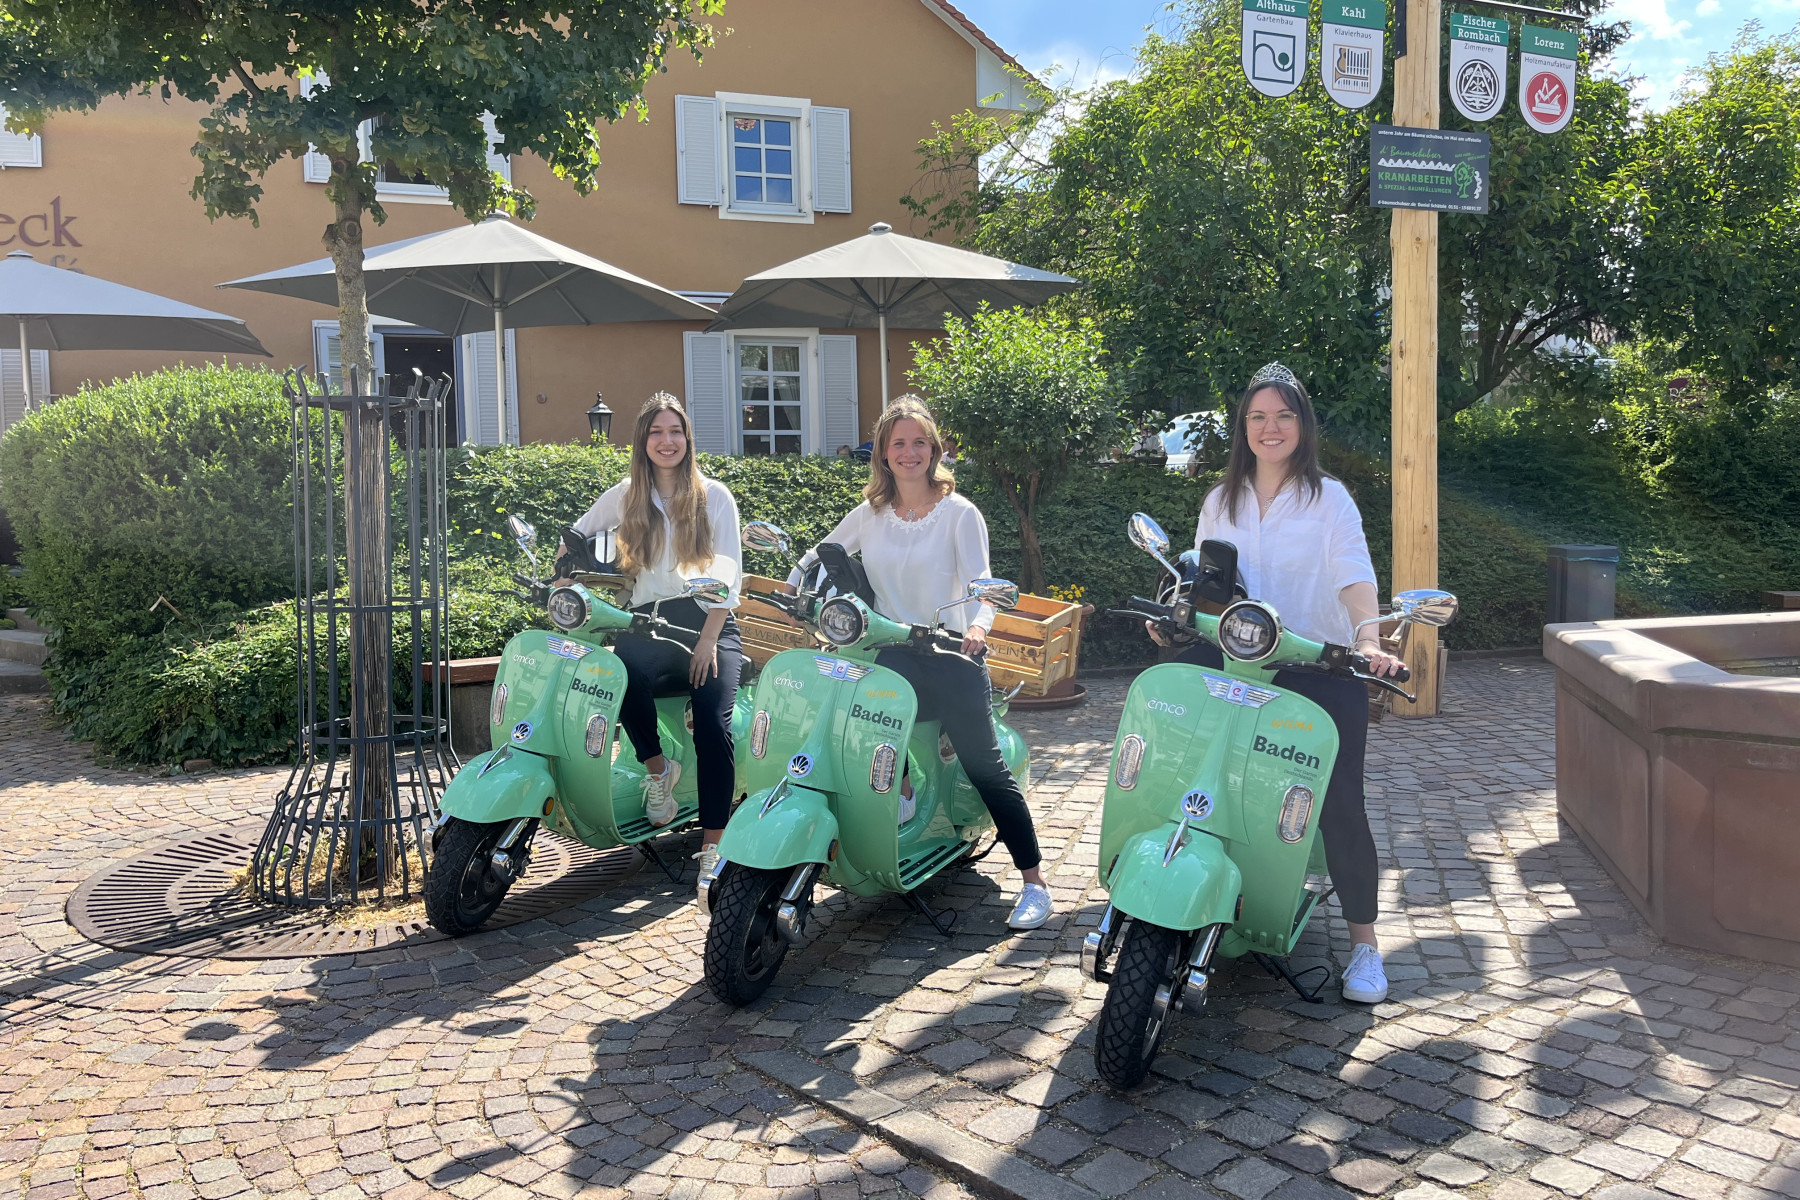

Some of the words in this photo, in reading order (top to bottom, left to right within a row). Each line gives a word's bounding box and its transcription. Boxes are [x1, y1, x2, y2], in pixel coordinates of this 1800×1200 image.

[1256, 0, 1296, 13] Althaus
[1341, 6, 1366, 19] Kahl
[1256, 14, 1294, 26] Gartenbau
[1463, 15, 1496, 29] Fischer
[1334, 28, 1372, 39] Klavierhaus
[1457, 28, 1501, 43] Rombach
[1463, 43, 1494, 53] Zimmerer
[1534, 36, 1565, 50] Lorenz
[1524, 56, 1572, 70] Holzmanufaktur
[1378, 172, 1452, 185] KRANARBEITEN
[0, 195, 83, 248] eck
[513, 653, 536, 666] emco
[571, 677, 614, 702] Baden
[775, 675, 804, 691] emco
[1147, 698, 1187, 717] emco
[850, 703, 903, 731] Baden
[1272, 718, 1313, 732] WILMA
[1253, 734, 1320, 770] Baden
